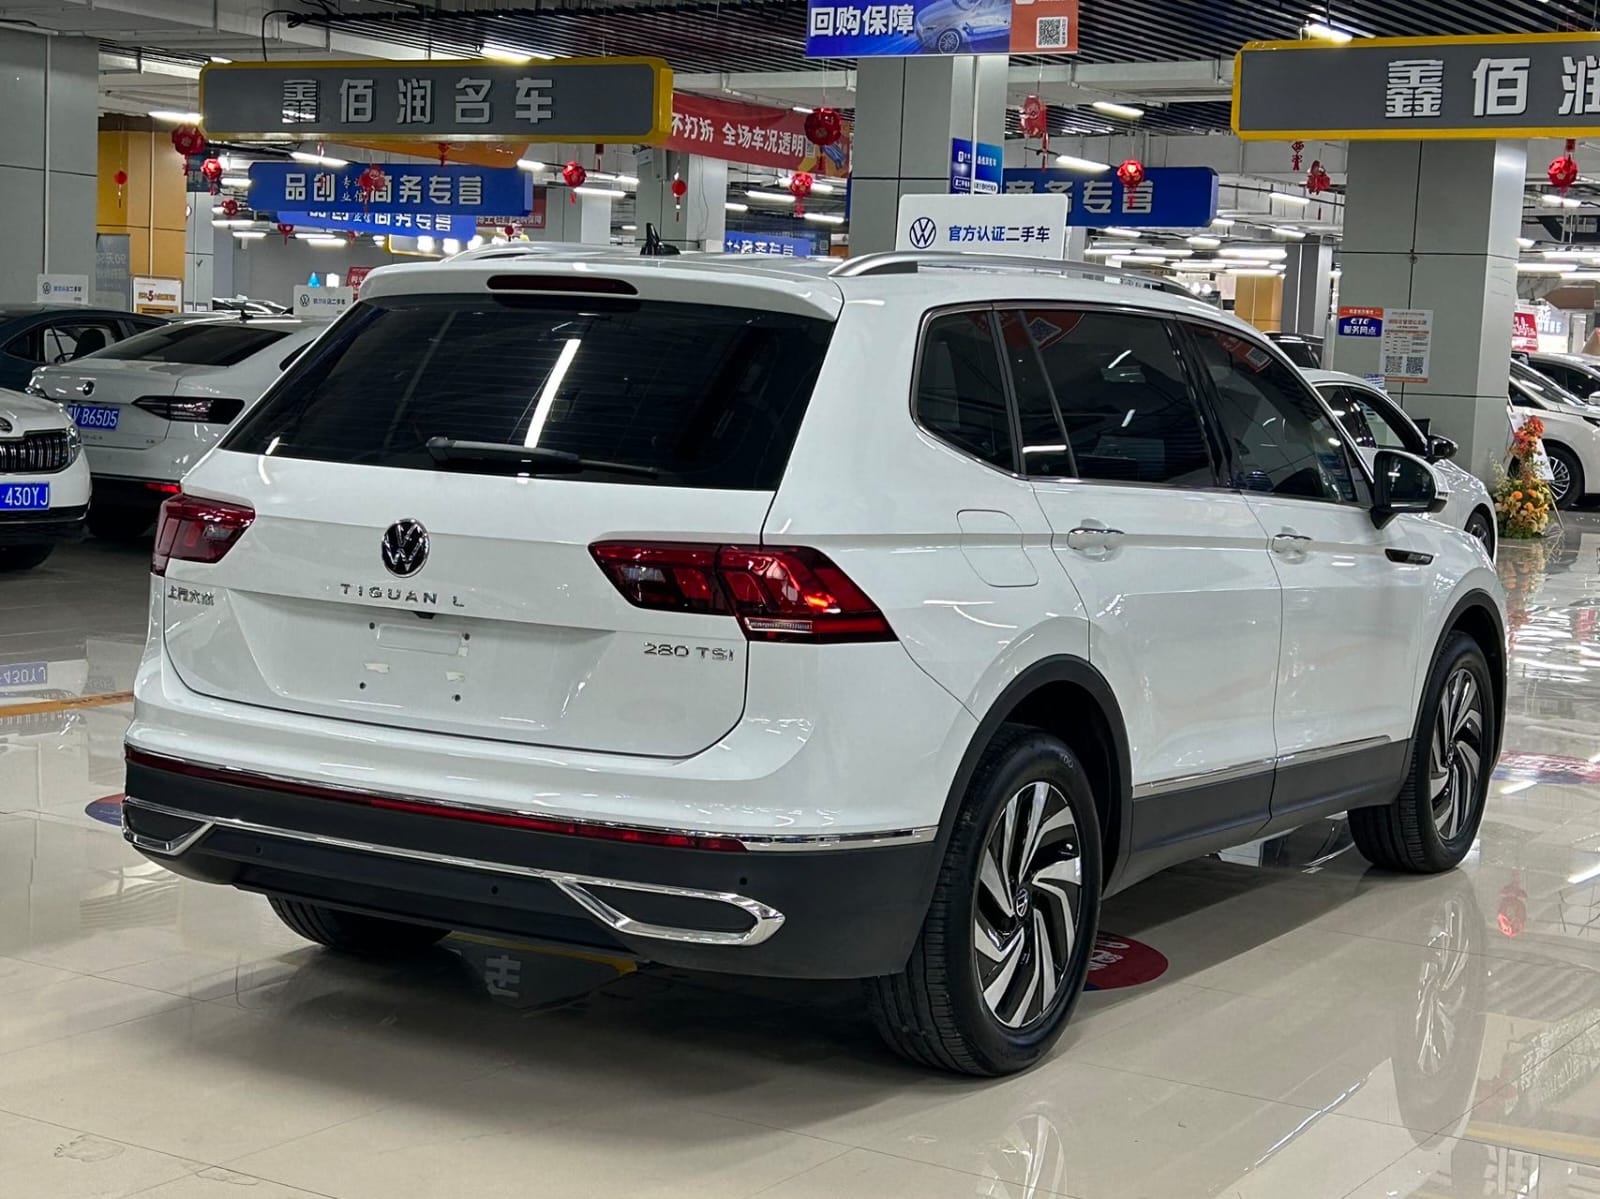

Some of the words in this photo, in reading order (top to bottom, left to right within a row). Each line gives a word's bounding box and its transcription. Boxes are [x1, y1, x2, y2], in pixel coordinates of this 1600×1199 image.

[810, 5, 914, 37] 回购保障
[282, 78, 553, 124] 鑫佰润名车
[722, 123, 804, 157] 全场车况透明
[948, 226, 1051, 243] 官方认证二手车
[340, 583, 437, 604] TIGUAN
[452, 595, 465, 607] L
[643, 642, 690, 657] 280
[695, 646, 735, 661] TSI
